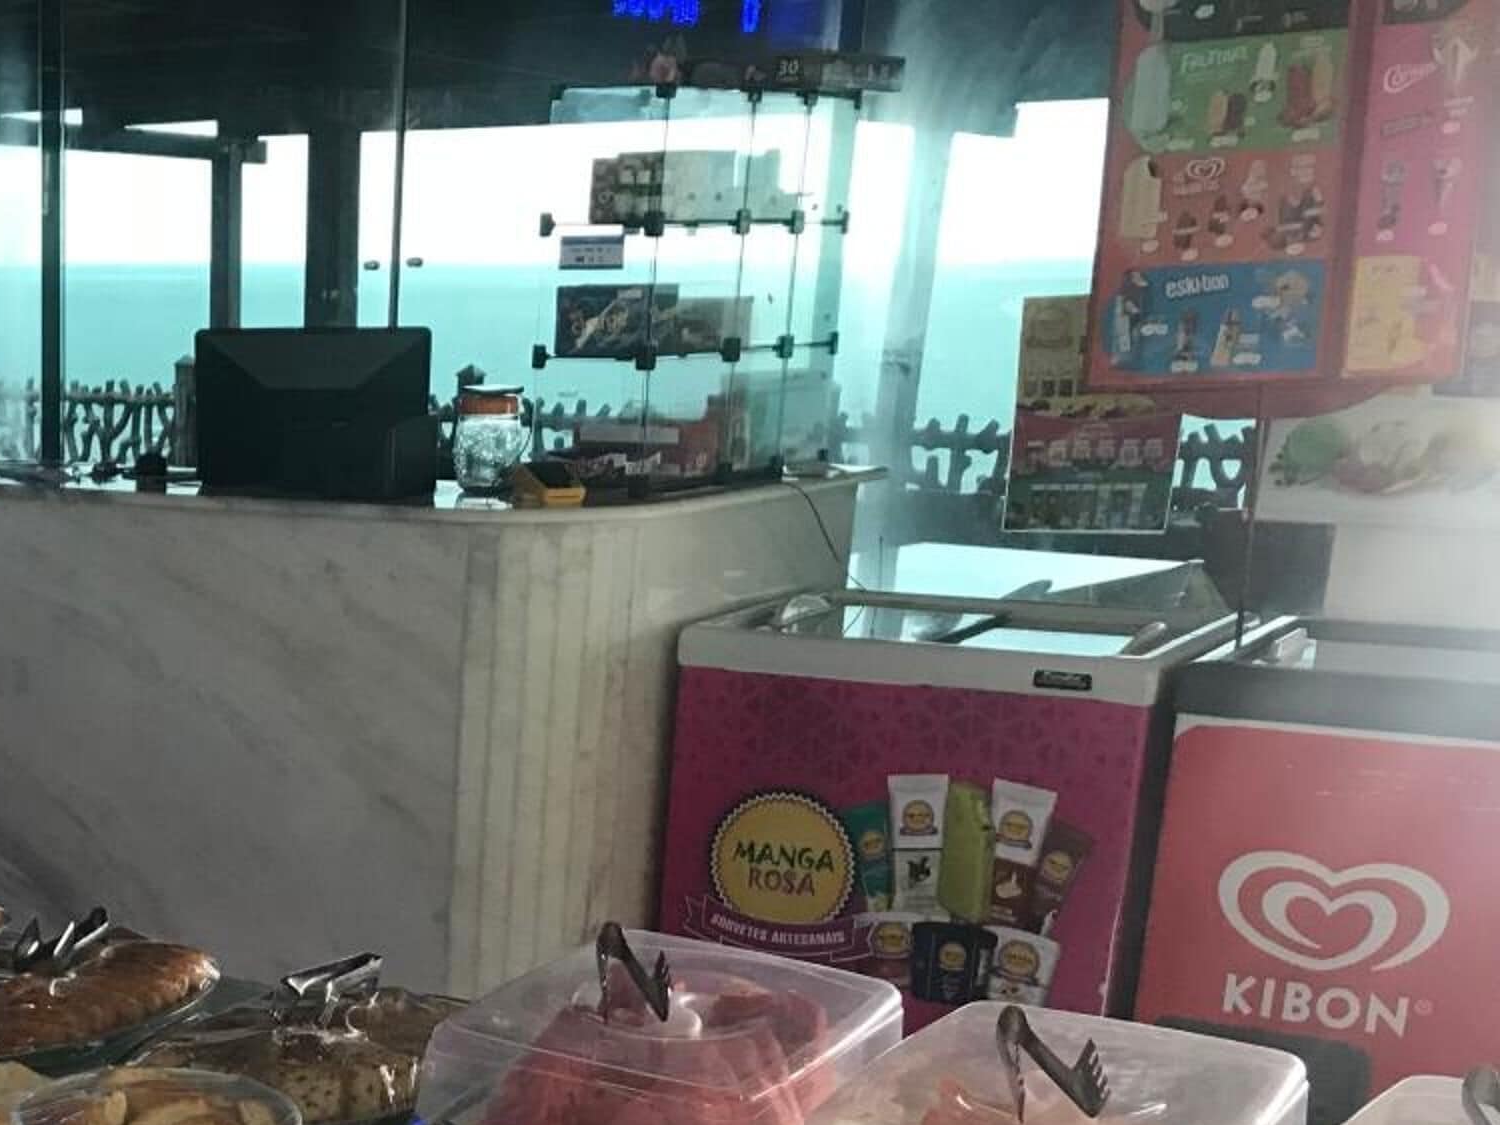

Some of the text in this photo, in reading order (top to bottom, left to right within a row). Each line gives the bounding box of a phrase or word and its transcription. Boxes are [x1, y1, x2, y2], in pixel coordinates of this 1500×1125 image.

[732, 840, 834, 872] MANGA
[748, 867, 816, 896] ROSA
[1222, 973, 1410, 1038] KIBON
